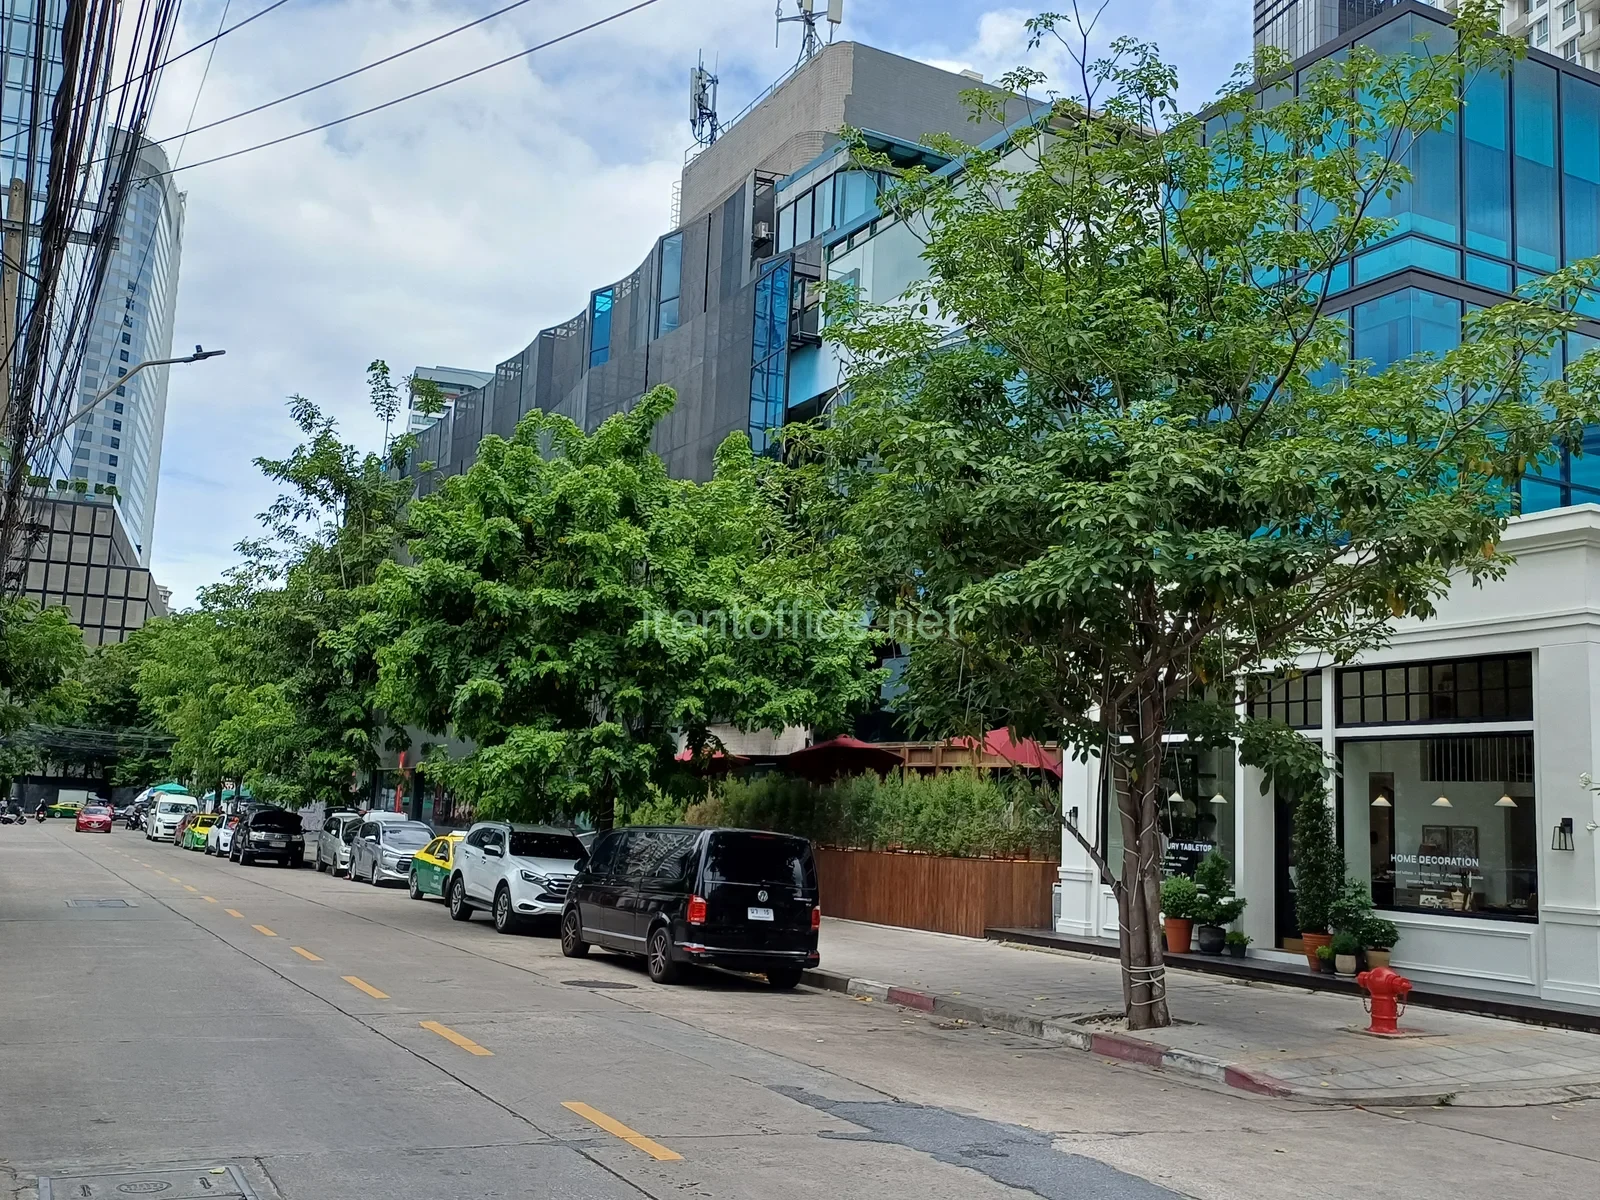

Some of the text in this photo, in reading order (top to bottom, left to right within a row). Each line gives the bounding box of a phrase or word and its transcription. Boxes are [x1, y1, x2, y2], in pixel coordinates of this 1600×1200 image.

[1180, 843, 1213, 852] TABLETOP
[1390, 854, 1479, 867] HOME DECORATION
